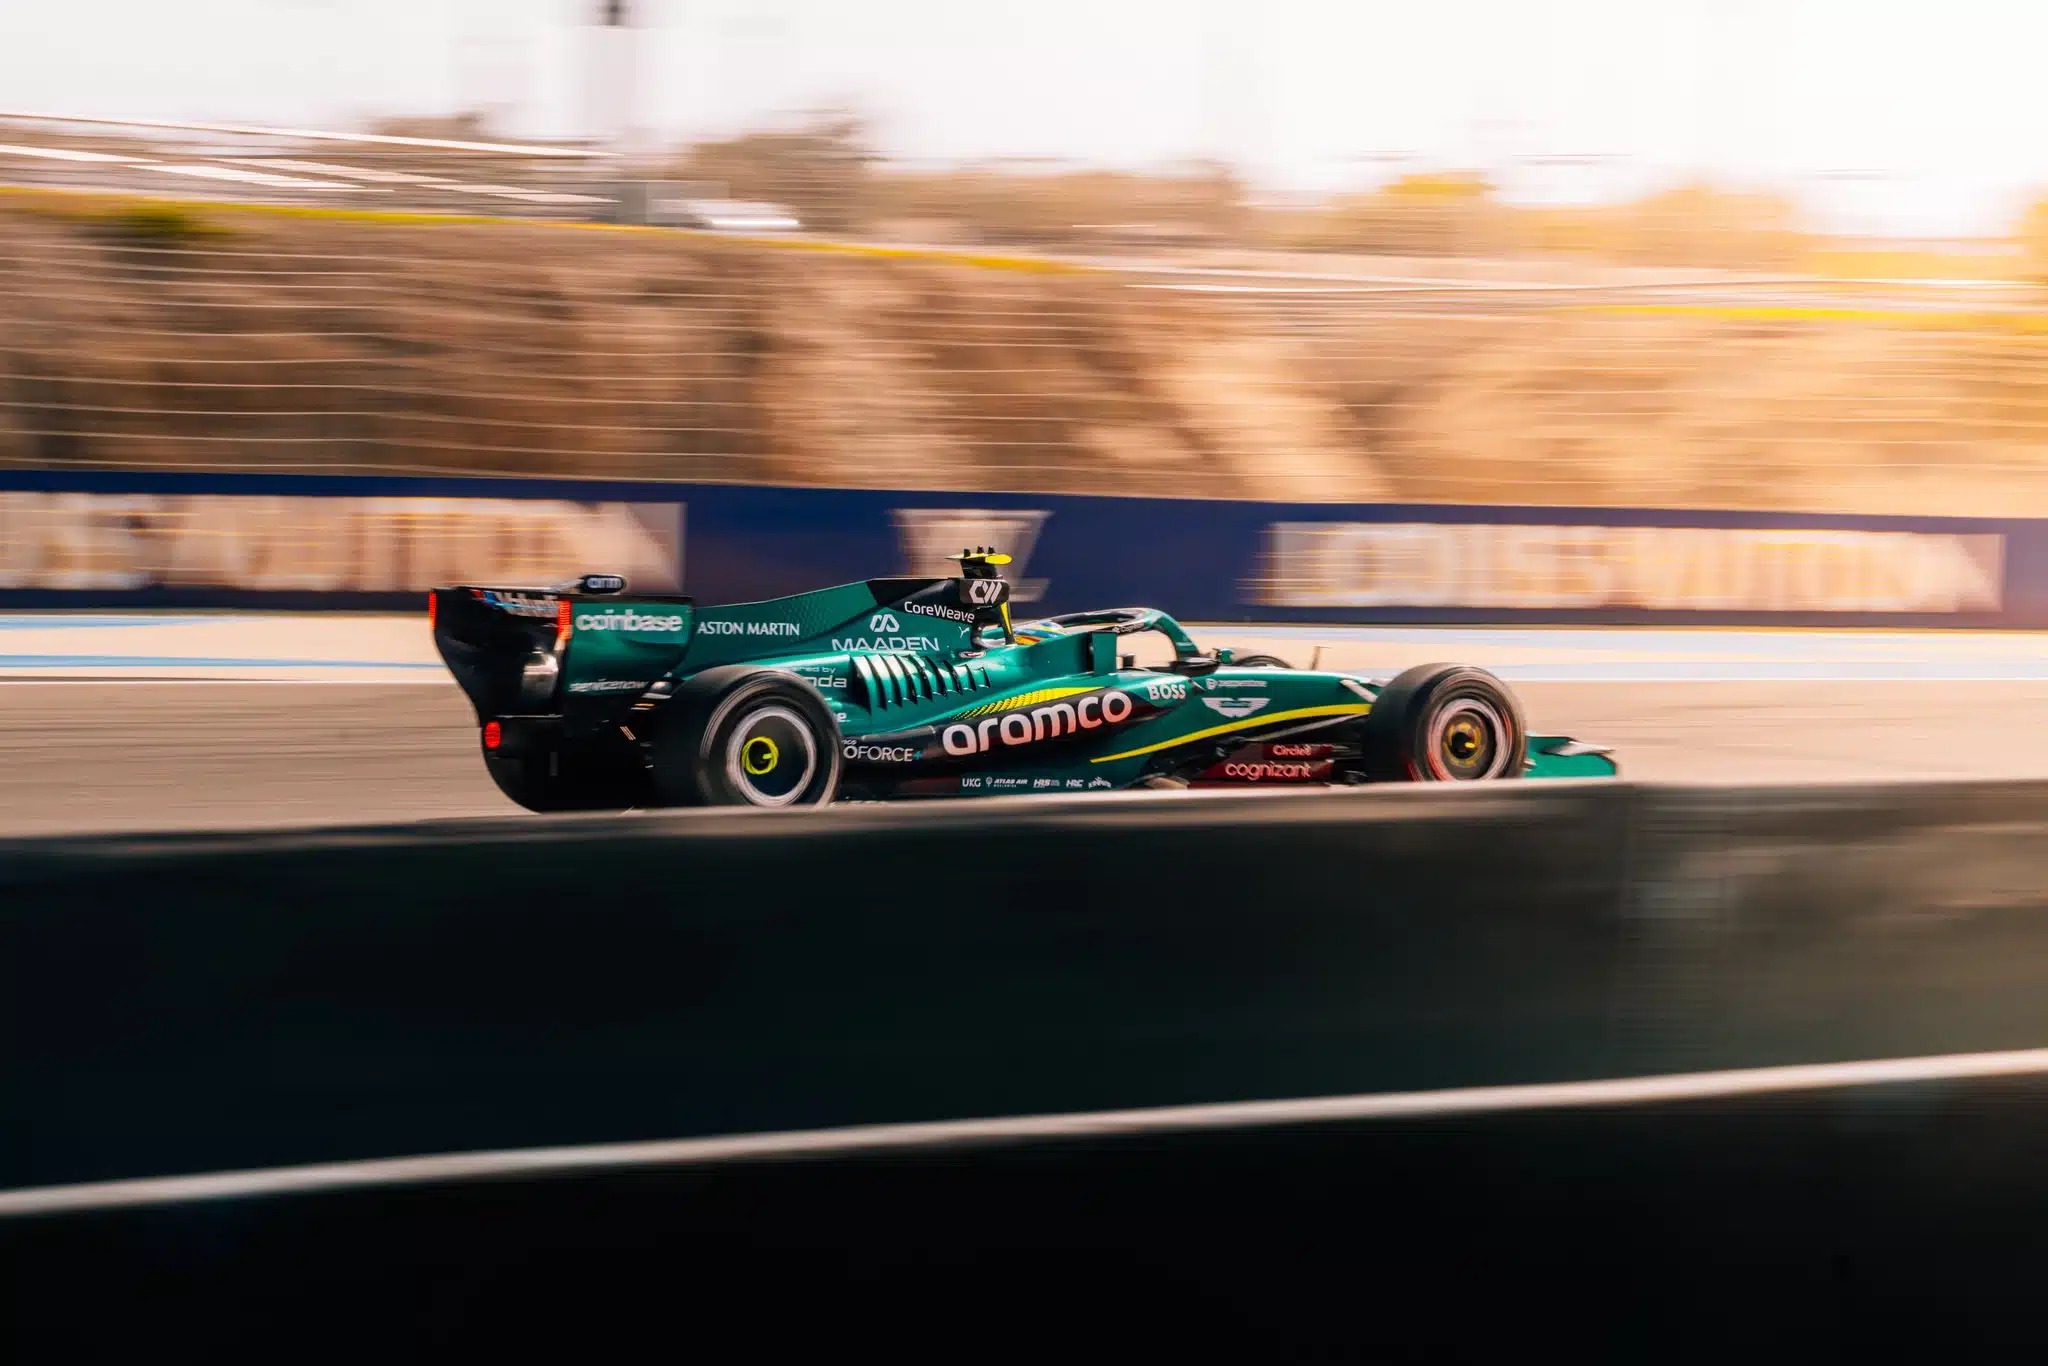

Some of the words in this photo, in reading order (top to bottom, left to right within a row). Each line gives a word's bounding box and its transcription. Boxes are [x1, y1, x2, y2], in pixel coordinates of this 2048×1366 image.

[575, 609, 684, 631] coinbase
[904, 601, 976, 624] CoreWeave
[697, 621, 744, 635] ASTON
[747, 622, 800, 636] MARTIN
[831, 637, 940, 651] MAADEN
[1147, 683, 1186, 700] BOSS
[942, 691, 1132, 756] aramco
[1225, 760, 1312, 781] cognizant
[962, 778, 982, 788] UKG
